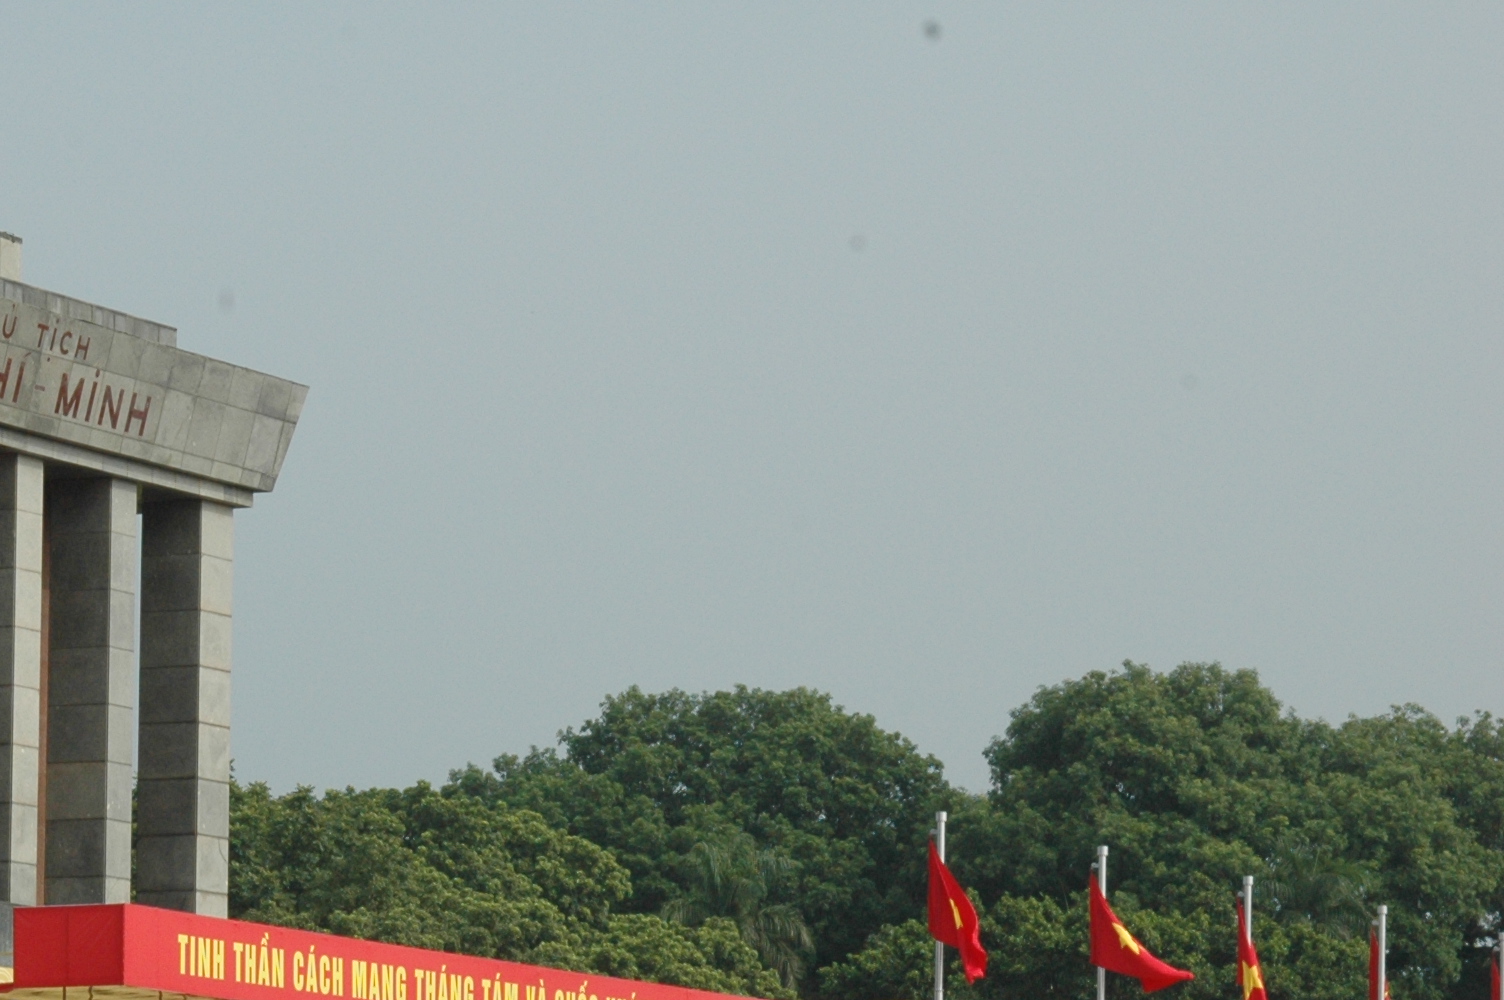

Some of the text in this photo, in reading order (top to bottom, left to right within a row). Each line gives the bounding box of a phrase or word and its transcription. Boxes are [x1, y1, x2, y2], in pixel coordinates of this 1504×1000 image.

[177, 933, 225, 980] TINH
[233, 932, 285, 989] THẦN
[293, 945, 344, 997] CÁCH
